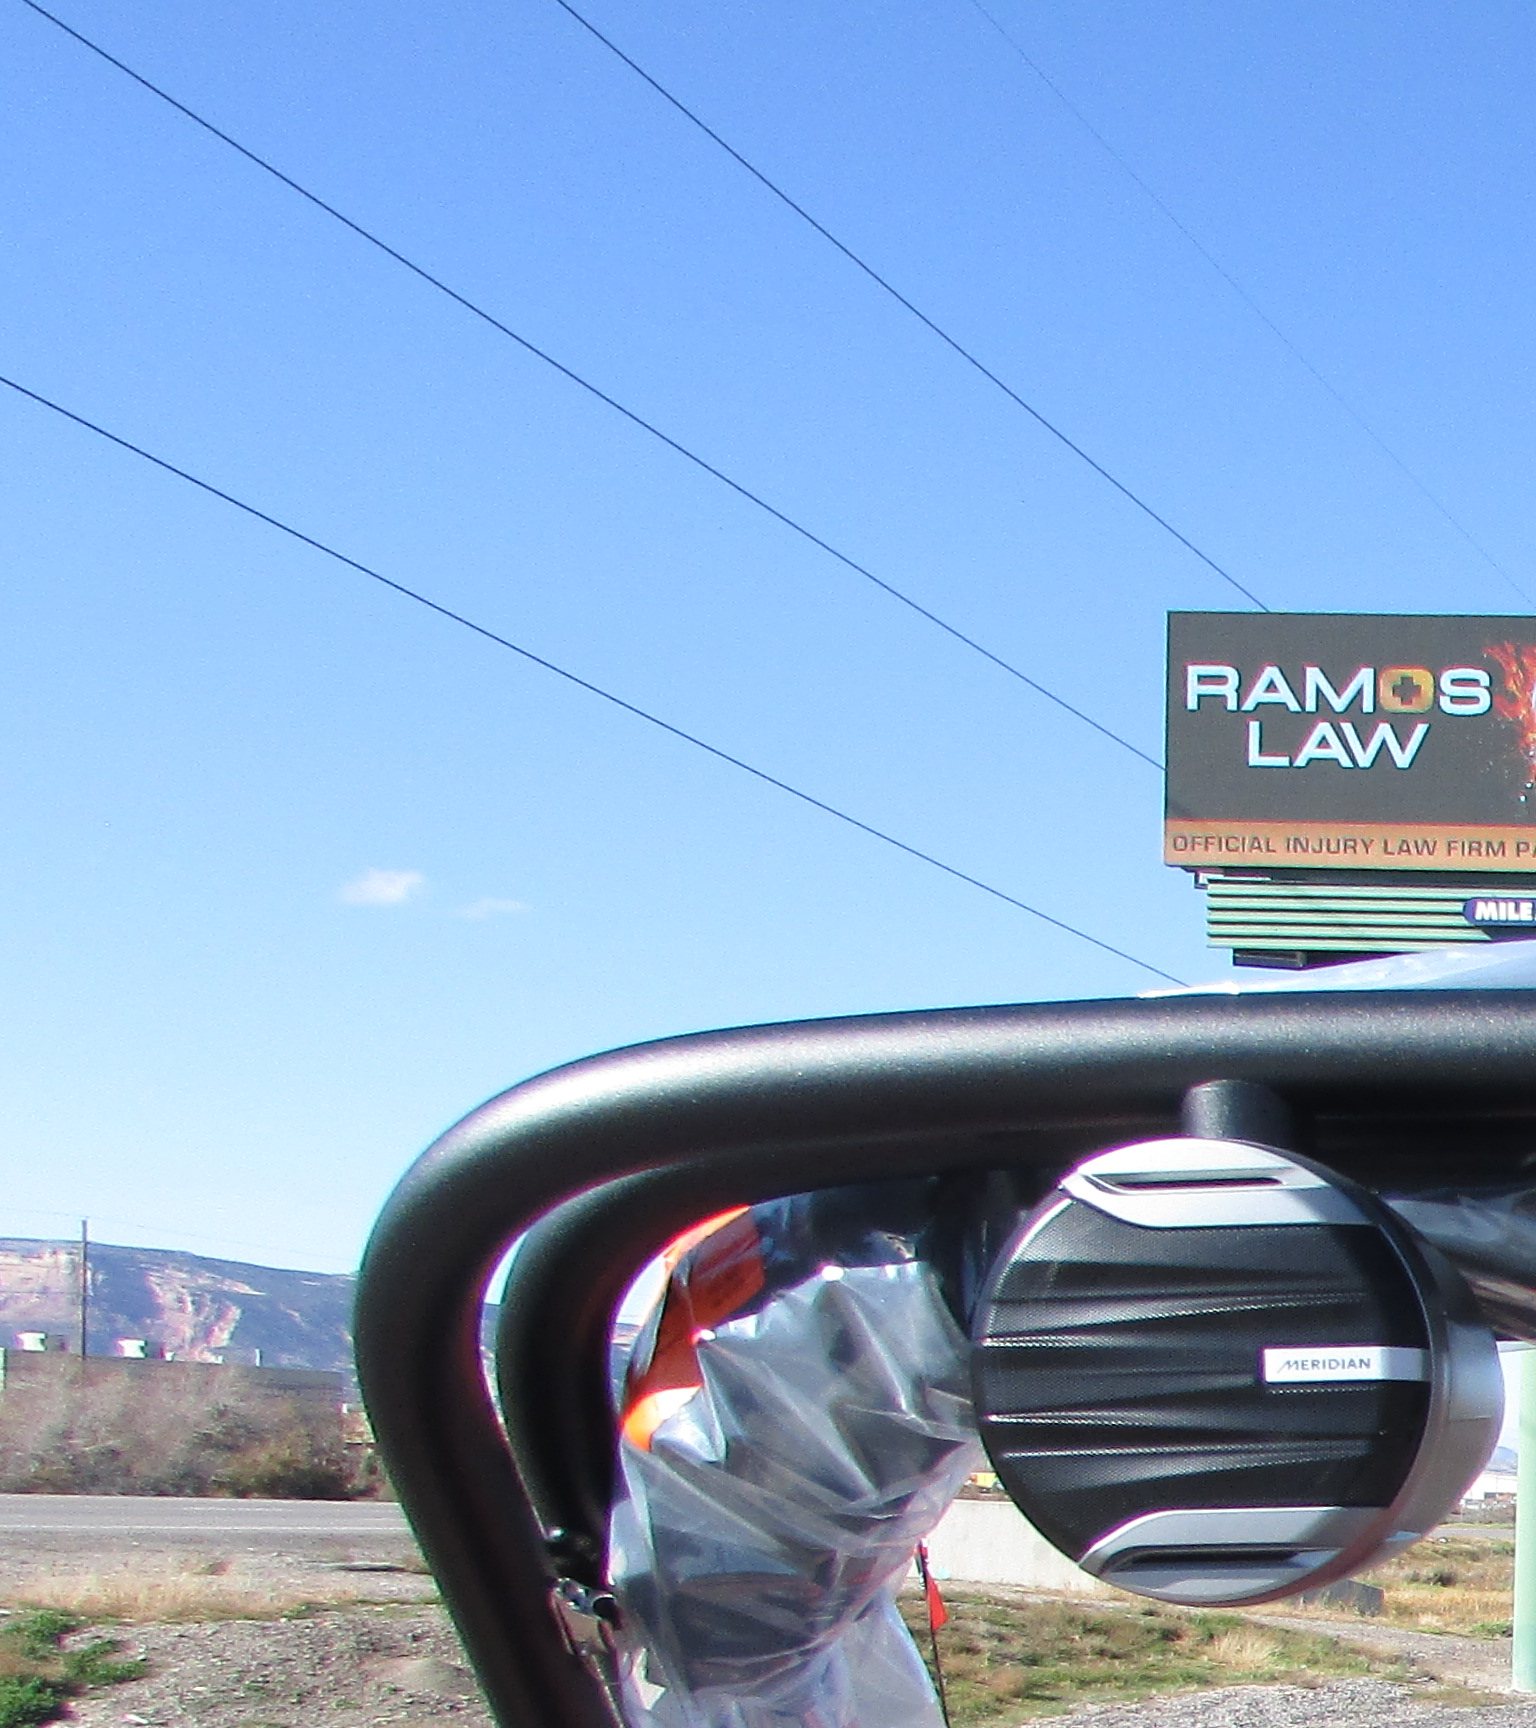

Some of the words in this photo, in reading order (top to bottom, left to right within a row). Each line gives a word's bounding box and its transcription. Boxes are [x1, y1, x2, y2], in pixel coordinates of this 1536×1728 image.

[1185, 664, 1491, 715] RAMOS
[1248, 720, 1430, 769] LAW
[1172, 835, 1277, 854] OFFICIAL
[1286, 837, 1375, 856] INJURY
[1383, 838, 1438, 857] LAW
[1446, 839, 1506, 858] FIRM
[1475, 901, 1533, 922] MILE
[1276, 1357, 1372, 1374] MERIDIAN
